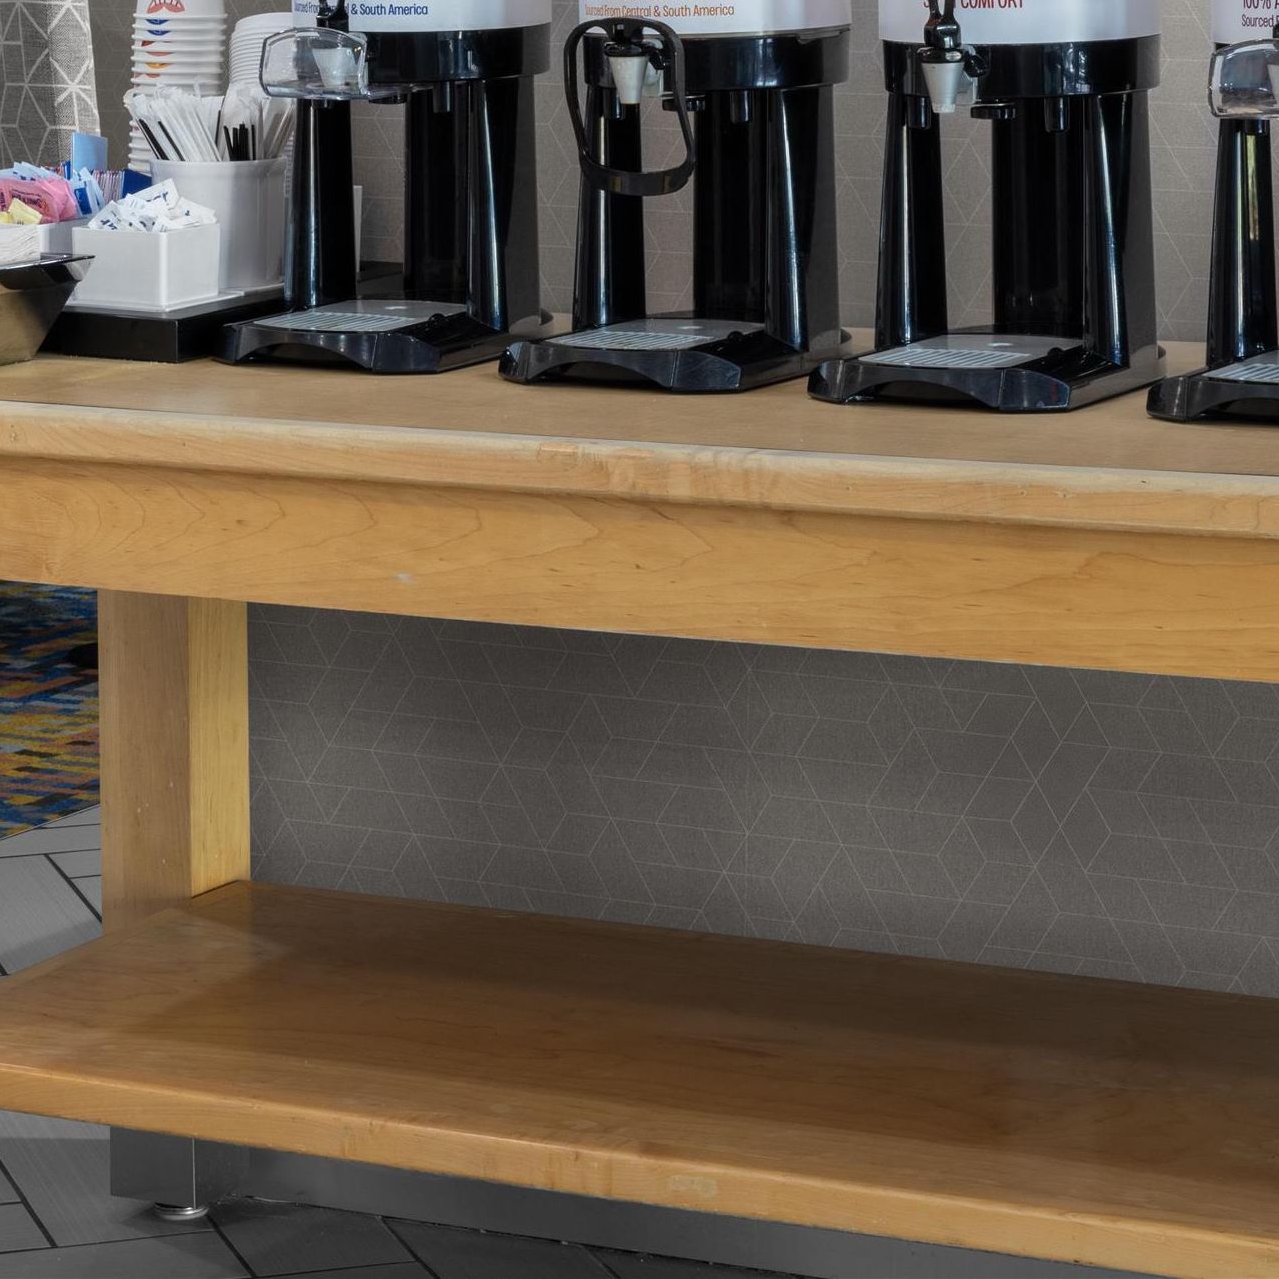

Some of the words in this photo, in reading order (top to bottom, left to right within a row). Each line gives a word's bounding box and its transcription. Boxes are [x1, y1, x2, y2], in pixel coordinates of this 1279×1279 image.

[351, 5, 358, 15] &
[359, 4, 386, 15] South
[388, 4, 428, 16] America
[653, 7, 661, 18] &
[663, 5, 690, 18] South
[693, 4, 735, 18] America
[1241, 14, 1274, 28] Sourced
